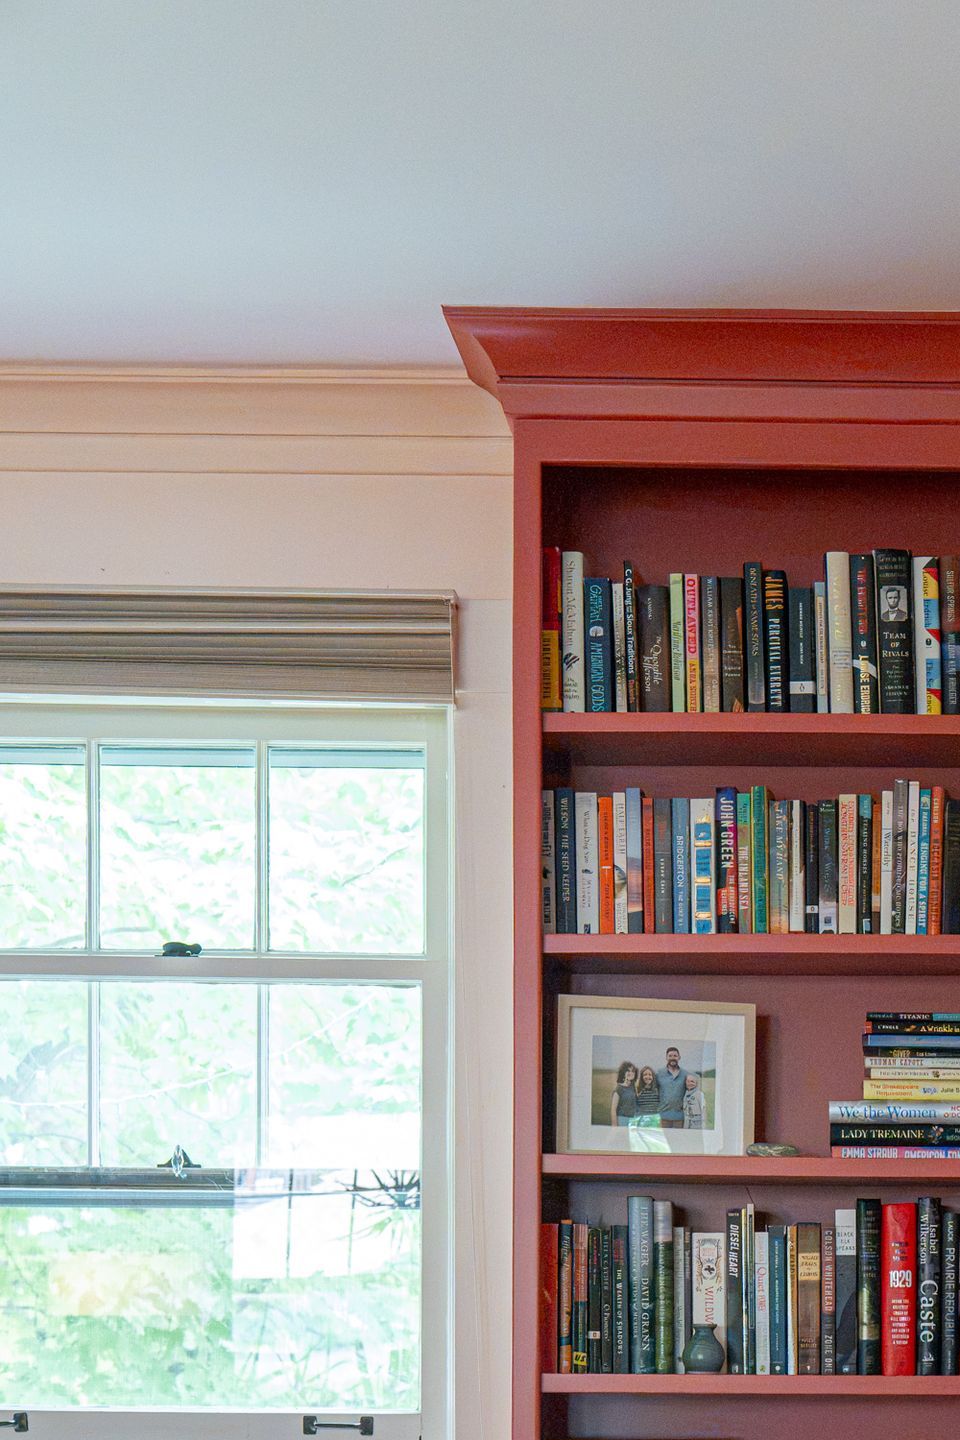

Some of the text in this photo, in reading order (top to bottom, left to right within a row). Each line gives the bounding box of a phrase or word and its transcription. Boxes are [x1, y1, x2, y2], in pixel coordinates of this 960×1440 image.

[625, 587, 633, 606] Jung
[766, 577, 784, 610] JAMES
[627, 614, 635, 635] Sioux
[686, 579, 697, 654] OUTLAWED
[627, 637, 636, 674] Traditions
[642, 656, 653, 692] Jefferson
[769, 619, 782, 706] PERCIVAL EVERETT
[591, 642, 605, 711] AMERICAN GODS
[720, 798, 735, 869] JOHN GREEN
[776, 836, 785, 850] MY
[883, 832, 893, 867] Waterlily
[676, 836, 685, 888] BRIDGERTON
[739, 895, 748, 909] SEA
[838, 1105, 937, 1119] We the Women
[841, 1129, 925, 1139] LADY TREMAINE
[641, 1230, 651, 1268] WAGER
[728, 1224, 740, 1277] DIESEL HEART
[920, 1213, 929, 1265] Wilkerson
[929, 1224, 938, 1254] Isabel
[889, 1269, 912, 1288] 1929
[945, 1247, 956, 1290] PRAIRIE
[641, 1278, 651, 1310] DAVID
[824, 1230, 833, 1373] COLSON WHITEHEAD ZONE ONE
[919, 1279, 939, 1343] Caste
[641, 1312, 651, 1351] GRANN
